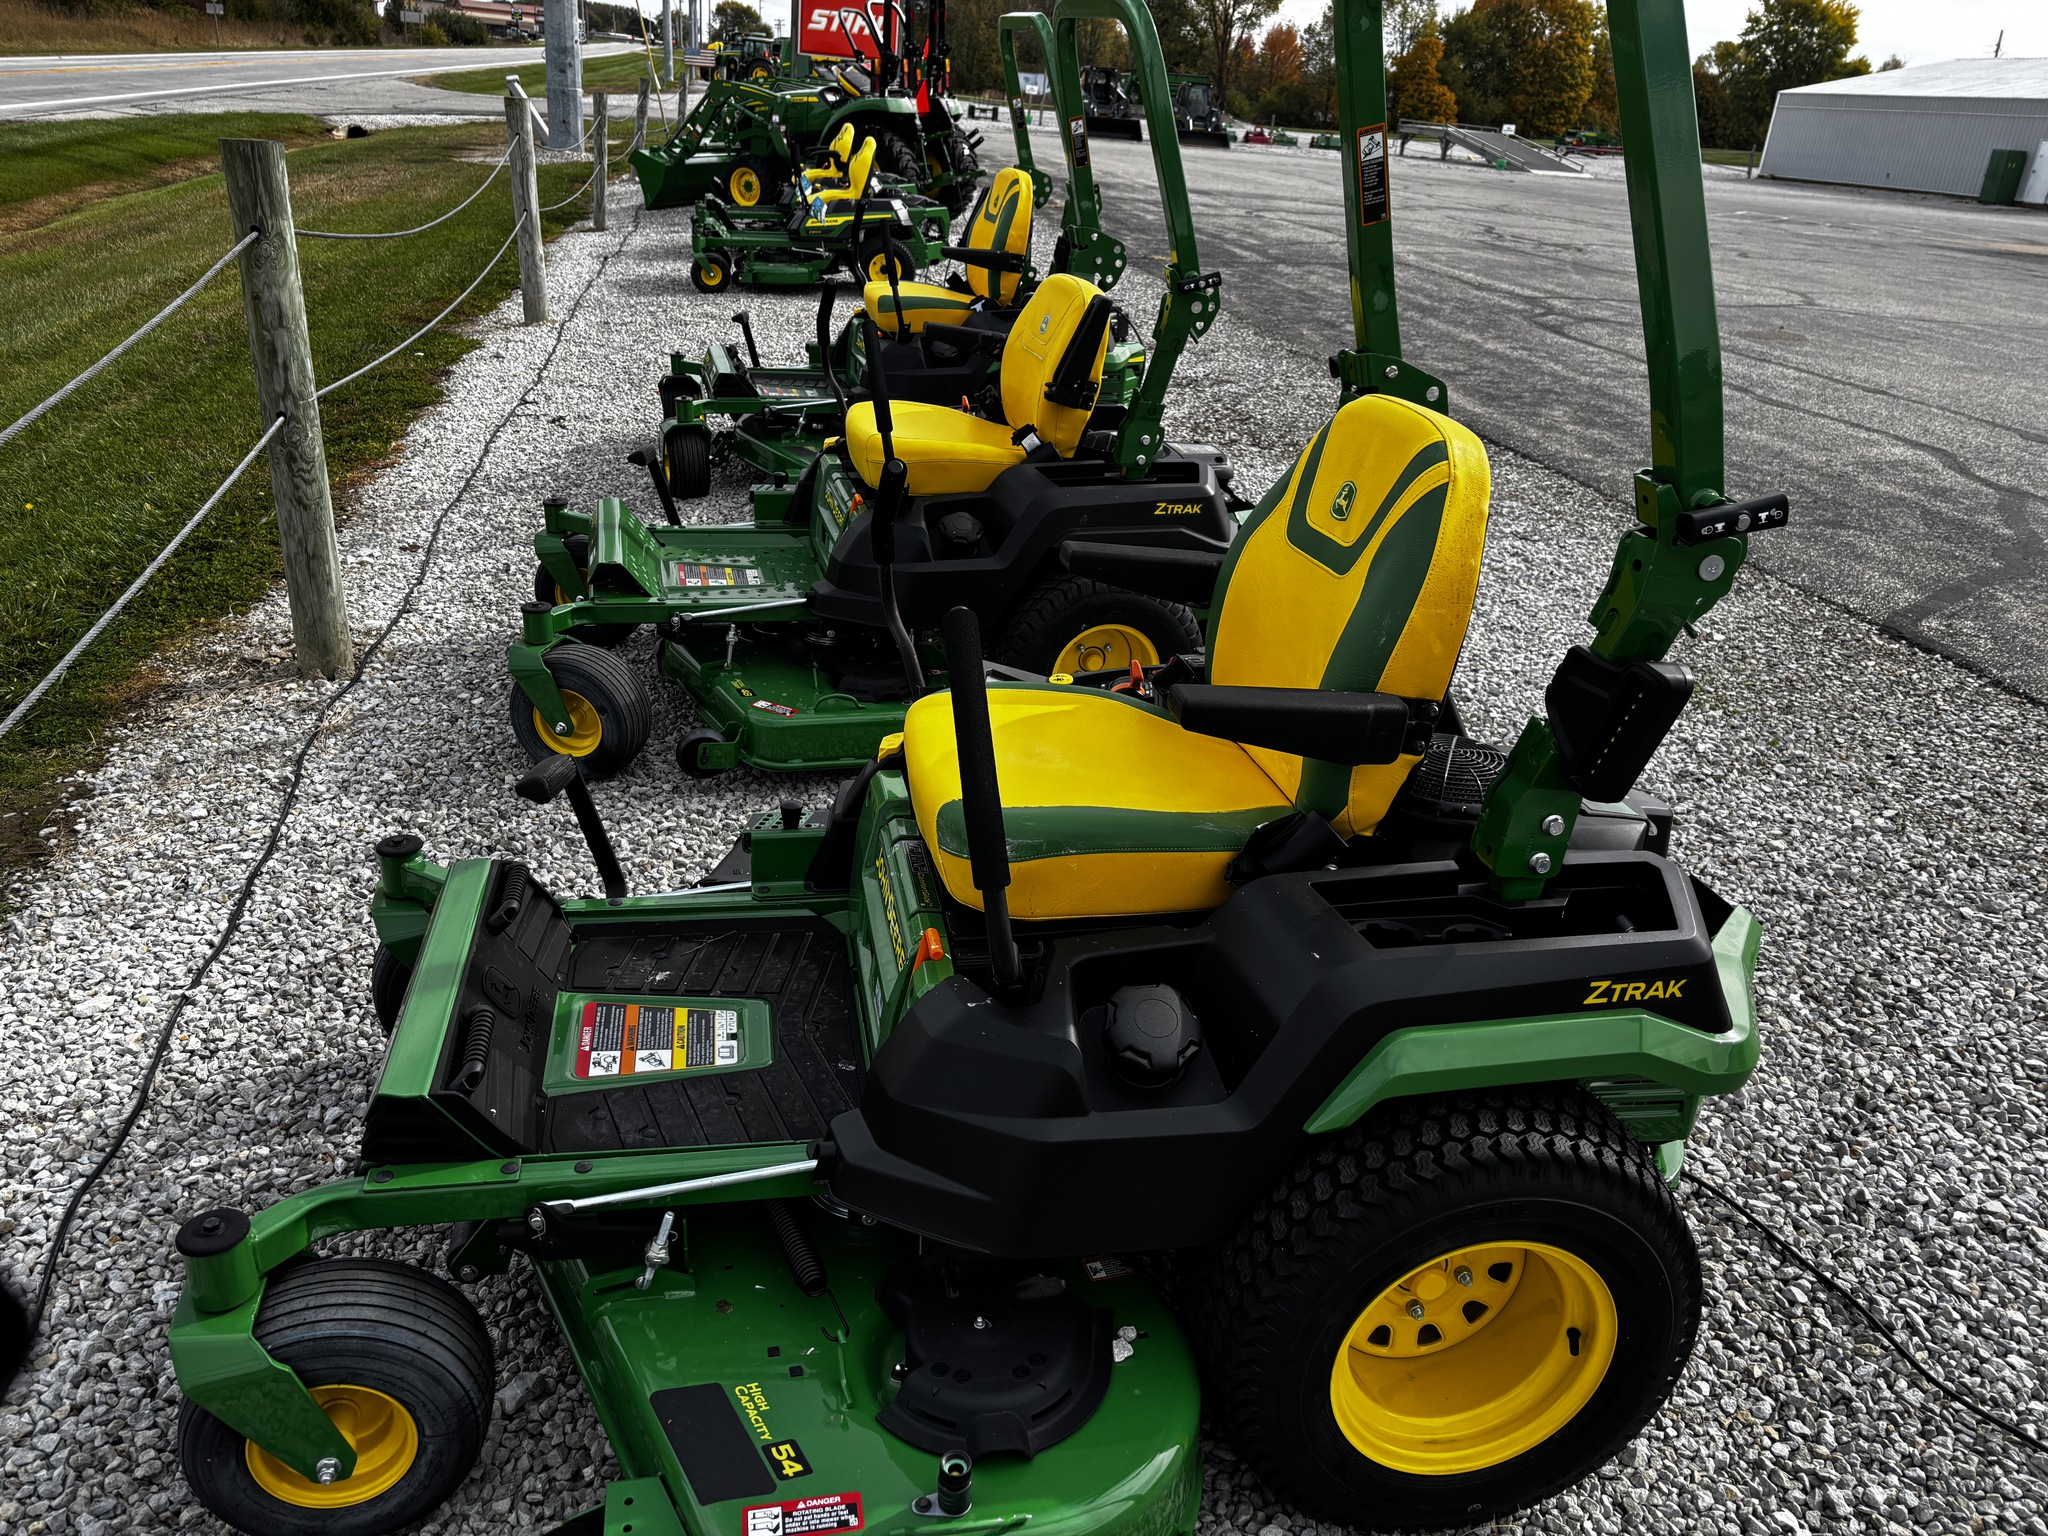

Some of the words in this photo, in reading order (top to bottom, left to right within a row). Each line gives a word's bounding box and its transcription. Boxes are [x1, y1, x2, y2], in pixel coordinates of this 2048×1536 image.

[1153, 502, 1203, 515] ZTRAK
[876, 848, 890, 906] JOHN
[886, 893, 906, 972] DEERE
[1583, 979, 1688, 1005] ZTRAK
[582, 1027, 592, 1045] DANGER
[626, 1024, 637, 1046] WARNING
[677, 1024, 686, 1045] CAUTION
[746, 1382, 770, 1411] HIGH
[734, 1385, 773, 1440] CAPACITY
[770, 1443, 804, 1477] 54
[793, 1507, 824, 1517] ROTATING
[824, 1504, 846, 1512] BLADE
[806, 1496, 841, 1507] DANGER
[785, 1525, 809, 1533] machine
[816, 1521, 837, 1530] running
